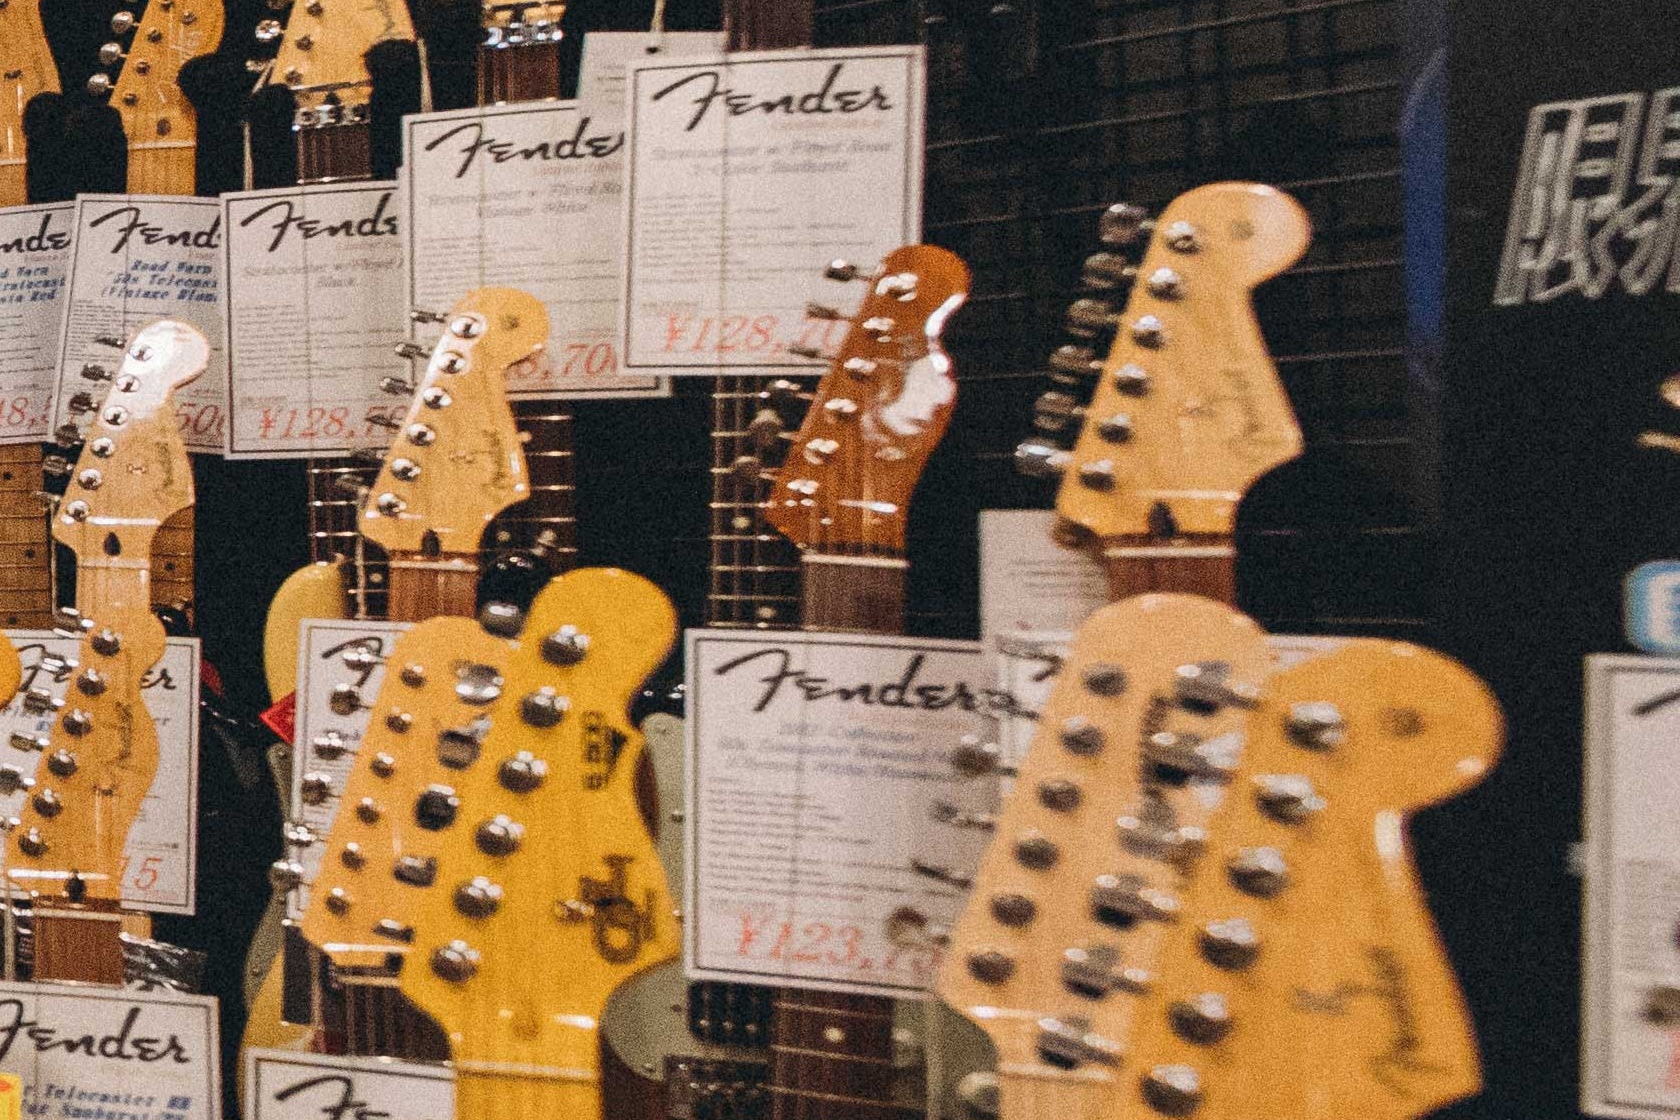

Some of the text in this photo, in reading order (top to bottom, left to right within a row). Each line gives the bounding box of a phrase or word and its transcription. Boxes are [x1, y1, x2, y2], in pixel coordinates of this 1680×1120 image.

[651, 64, 893, 131] Fender
[90, 207, 221, 254] Fend
[662, 312, 852, 354] ¥128,70
[714, 648, 979, 711] Fender
